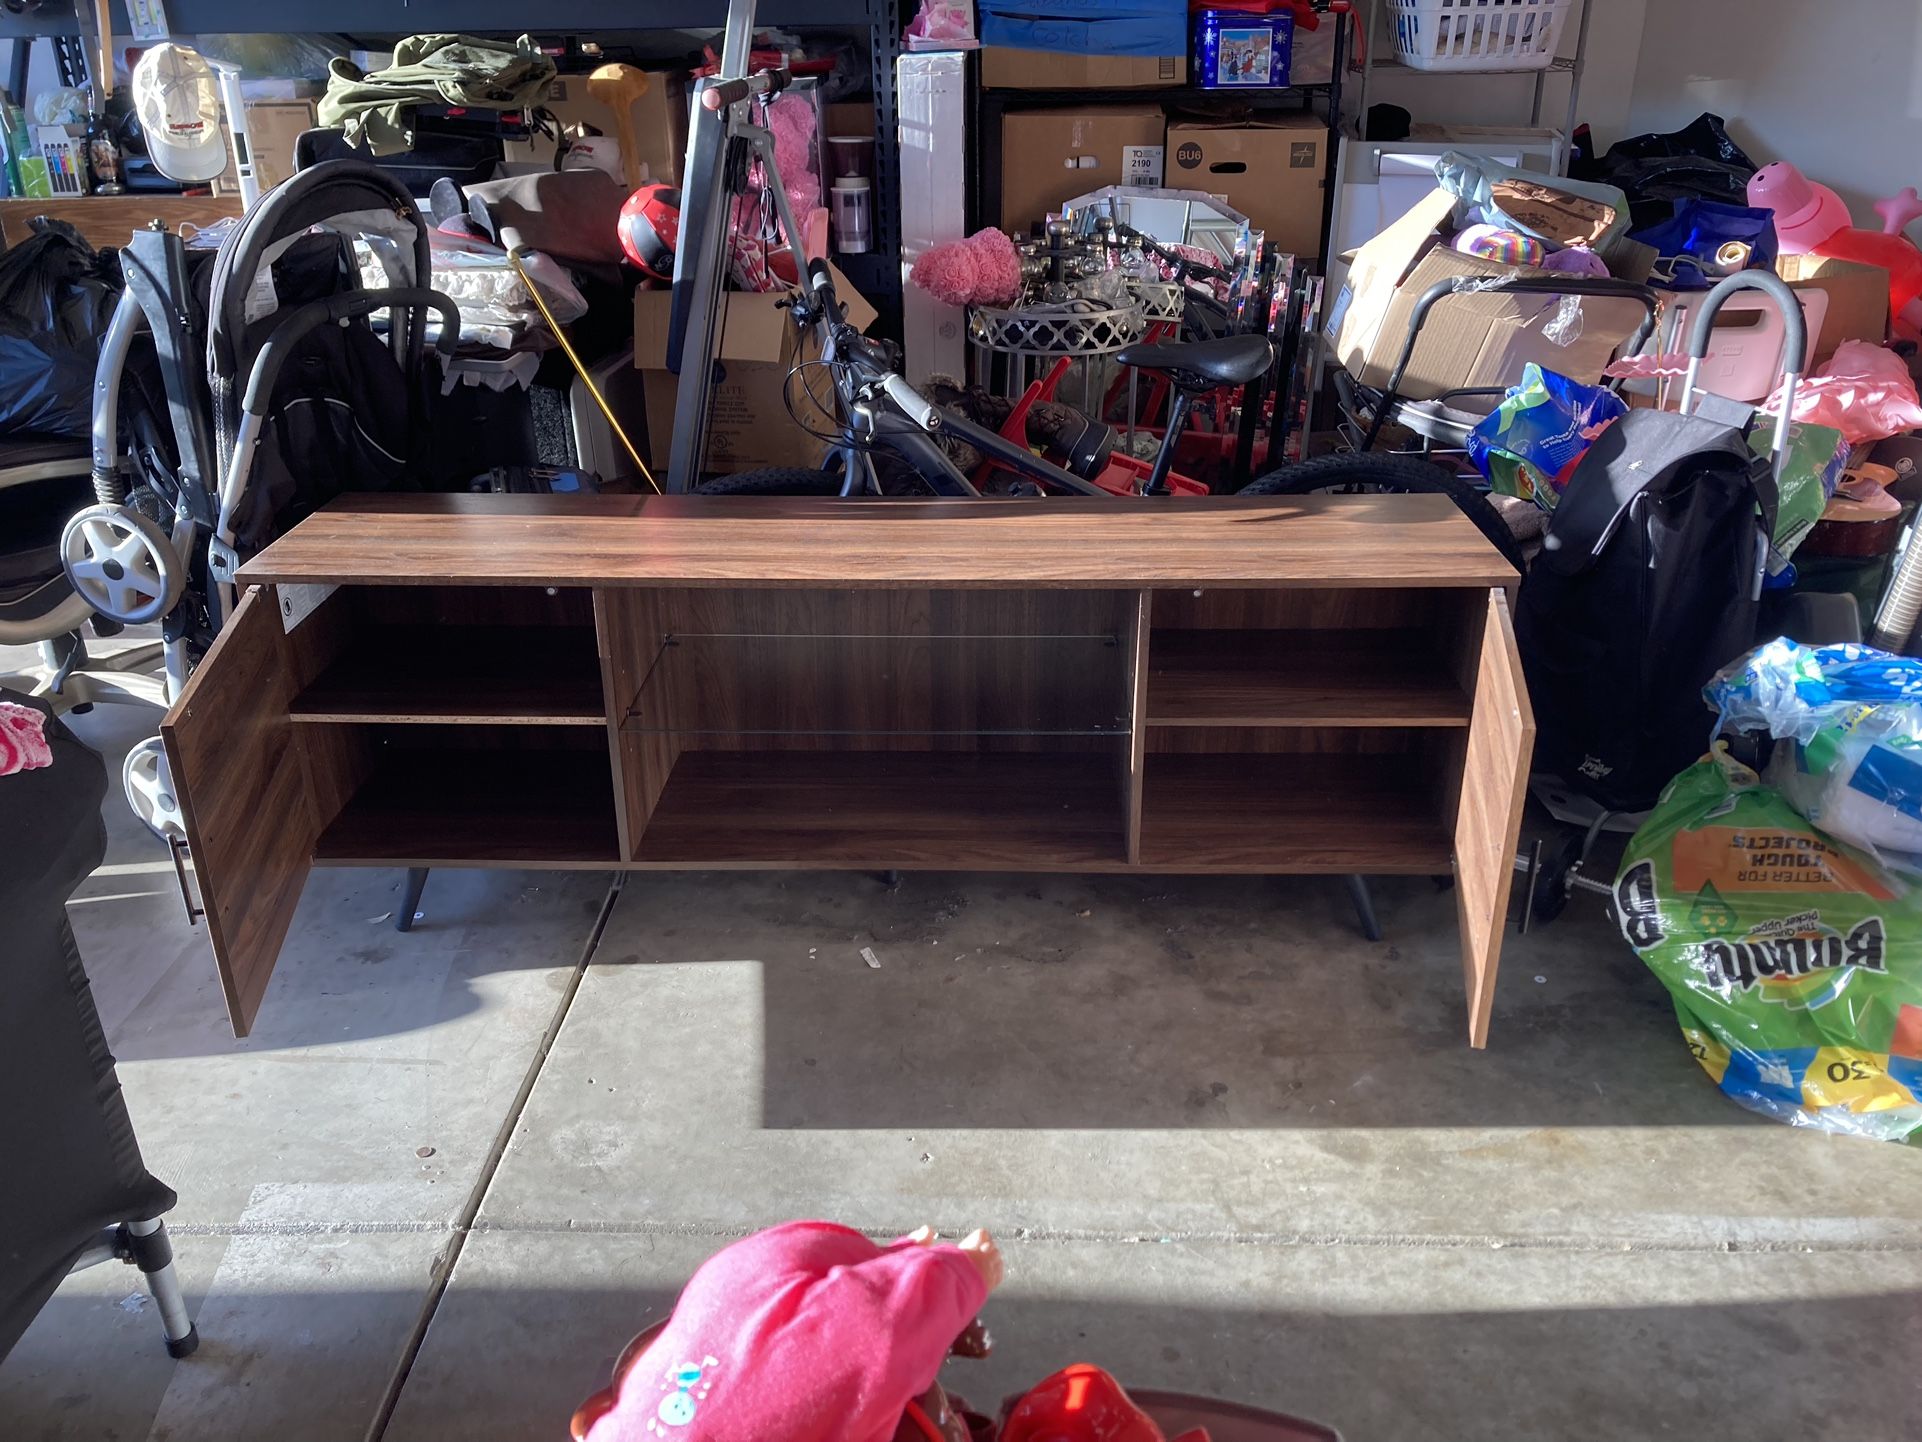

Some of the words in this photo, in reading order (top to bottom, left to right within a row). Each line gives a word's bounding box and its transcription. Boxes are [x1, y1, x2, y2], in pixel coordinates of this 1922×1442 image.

[1178, 150, 1202, 160] BU6
[1131, 159, 1151, 168] 2190
[1751, 853, 1824, 868] TOUGH
[1737, 870, 1768, 882] FOR
[1703, 917, 1886, 991] Bounty
